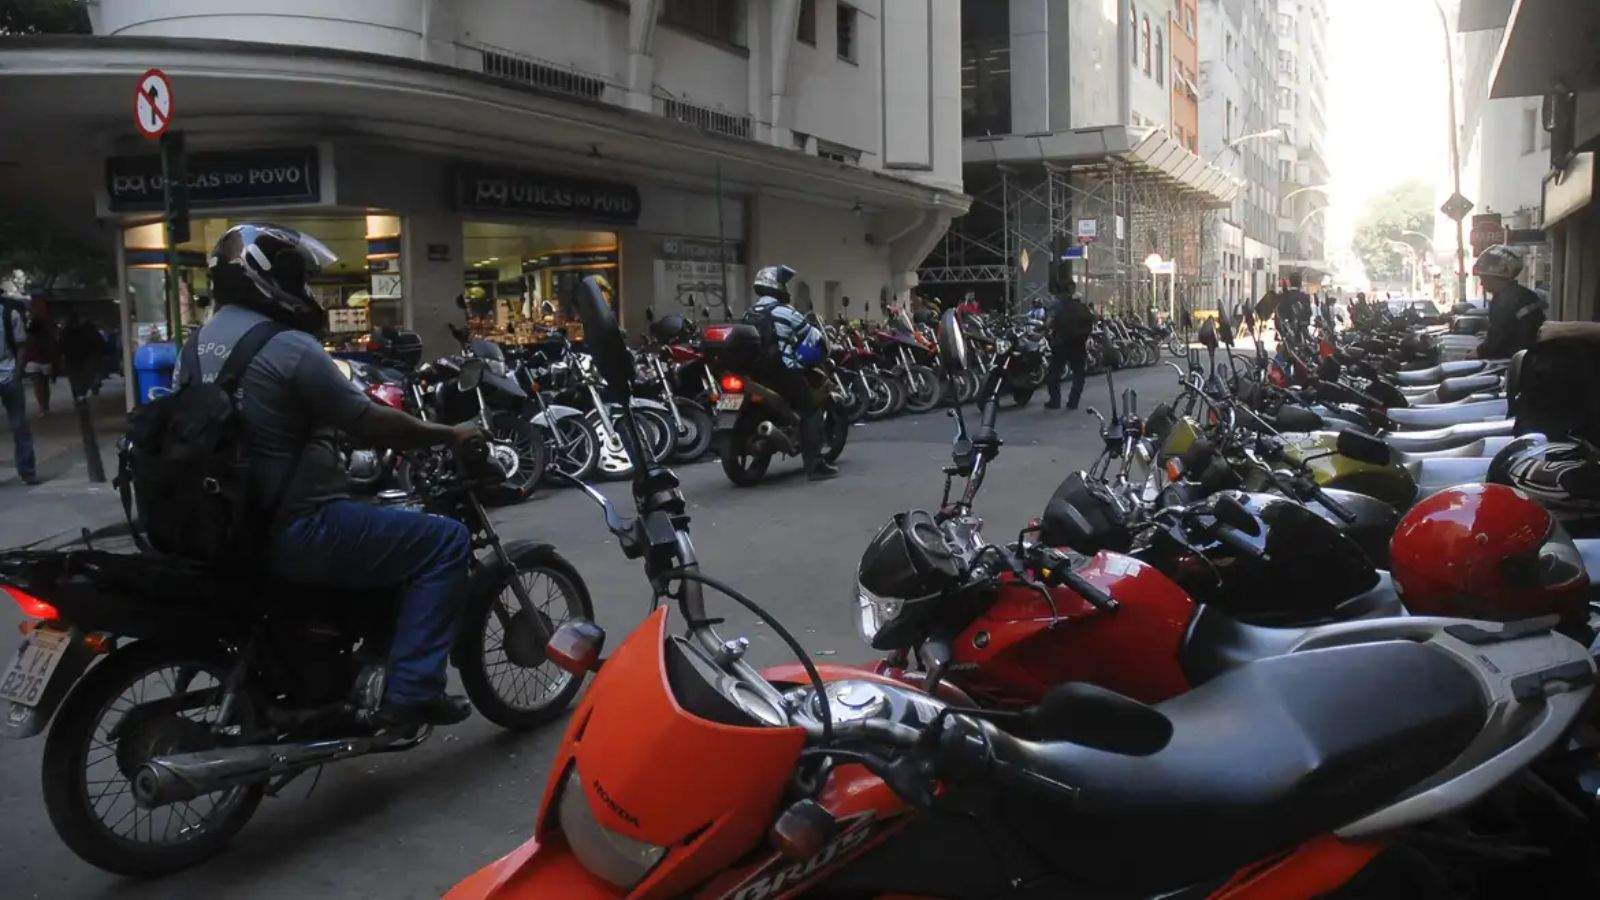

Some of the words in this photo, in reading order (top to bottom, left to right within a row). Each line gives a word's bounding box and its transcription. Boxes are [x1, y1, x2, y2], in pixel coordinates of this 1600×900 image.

[225, 174, 244, 184] DO
[249, 167, 300, 184] POVO
[1, 671, 42, 702] 8276
[593, 779, 640, 828] HONDA
